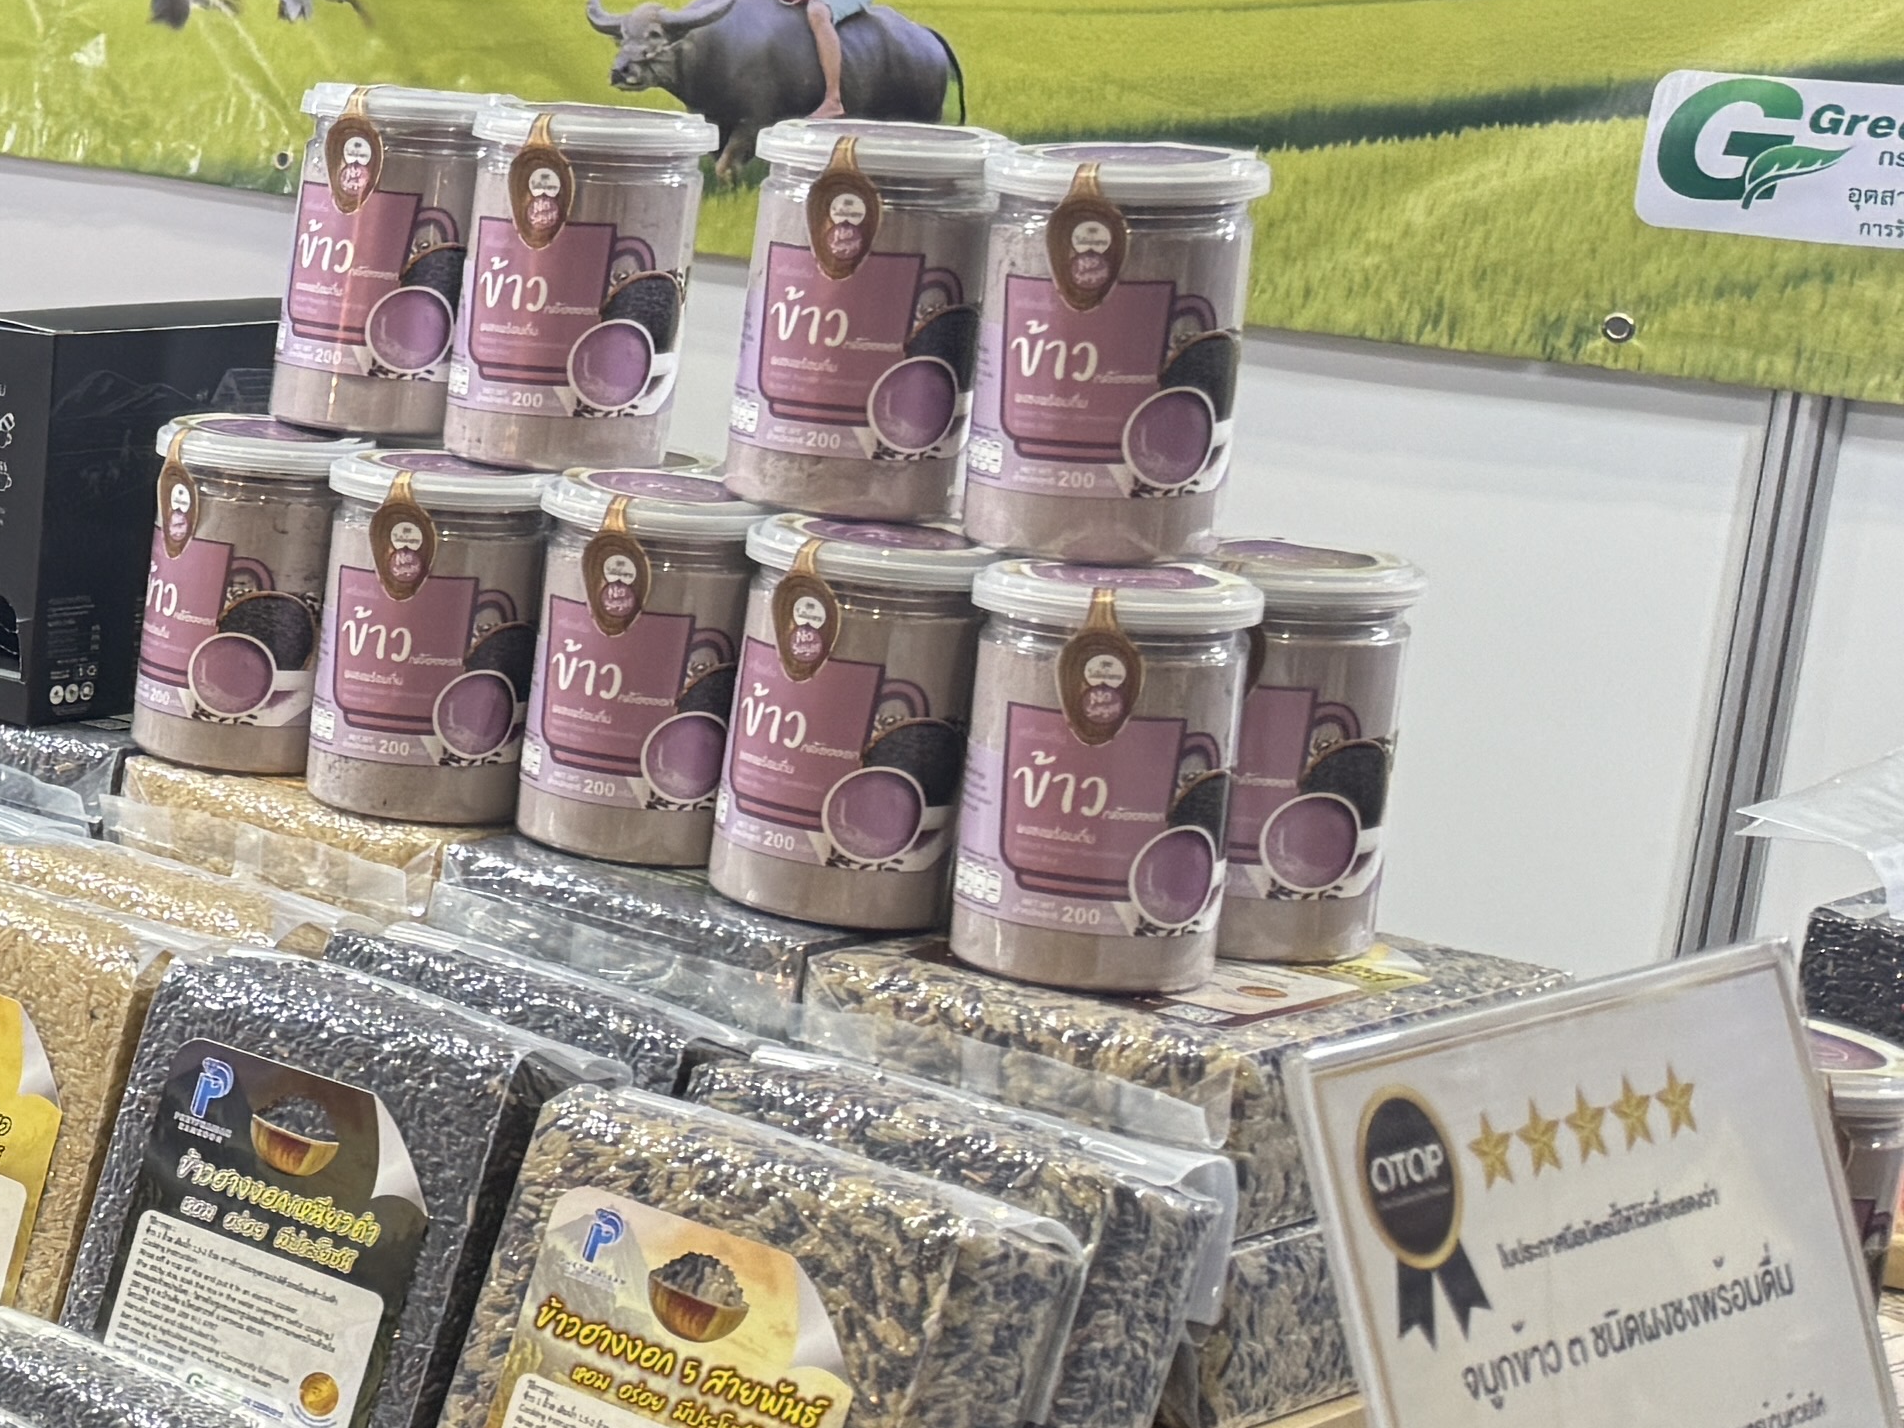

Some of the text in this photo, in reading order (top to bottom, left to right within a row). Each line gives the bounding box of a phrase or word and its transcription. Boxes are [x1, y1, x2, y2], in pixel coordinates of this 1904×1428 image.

[299, 219, 354, 274] ข้าว
[480, 255, 548, 312] ข้าว
[770, 286, 848, 348] ข้าว
[315, 348, 342, 365] 200
[1012, 320, 1098, 383] ข้าว
[512, 391, 543, 408] 200
[806, 431, 841, 449] 200
[1058, 470, 1095, 489] 200
[341, 607, 412, 662] ข้าว
[150, 687, 170, 705] 200
[551, 641, 623, 701] ข้าว
[740, 682, 807, 750] ข้าว
[378, 740, 410, 757] 200
[583, 780, 616, 798] 200
[1012, 751, 1108, 818] ข้าว
[763, 831, 796, 852] 200
[1062, 907, 1101, 927] 200
[1370, 1142, 1446, 1196] OTOP
[532, 1301, 679, 1373] ข้าวฮางงอก
[678, 1357, 701, 1388] 5
[1461, 1318, 1563, 1411] จมูกข้าว
[569, 1362, 612, 1392] หอม
[616, 1378, 668, 1411] อร่อย
